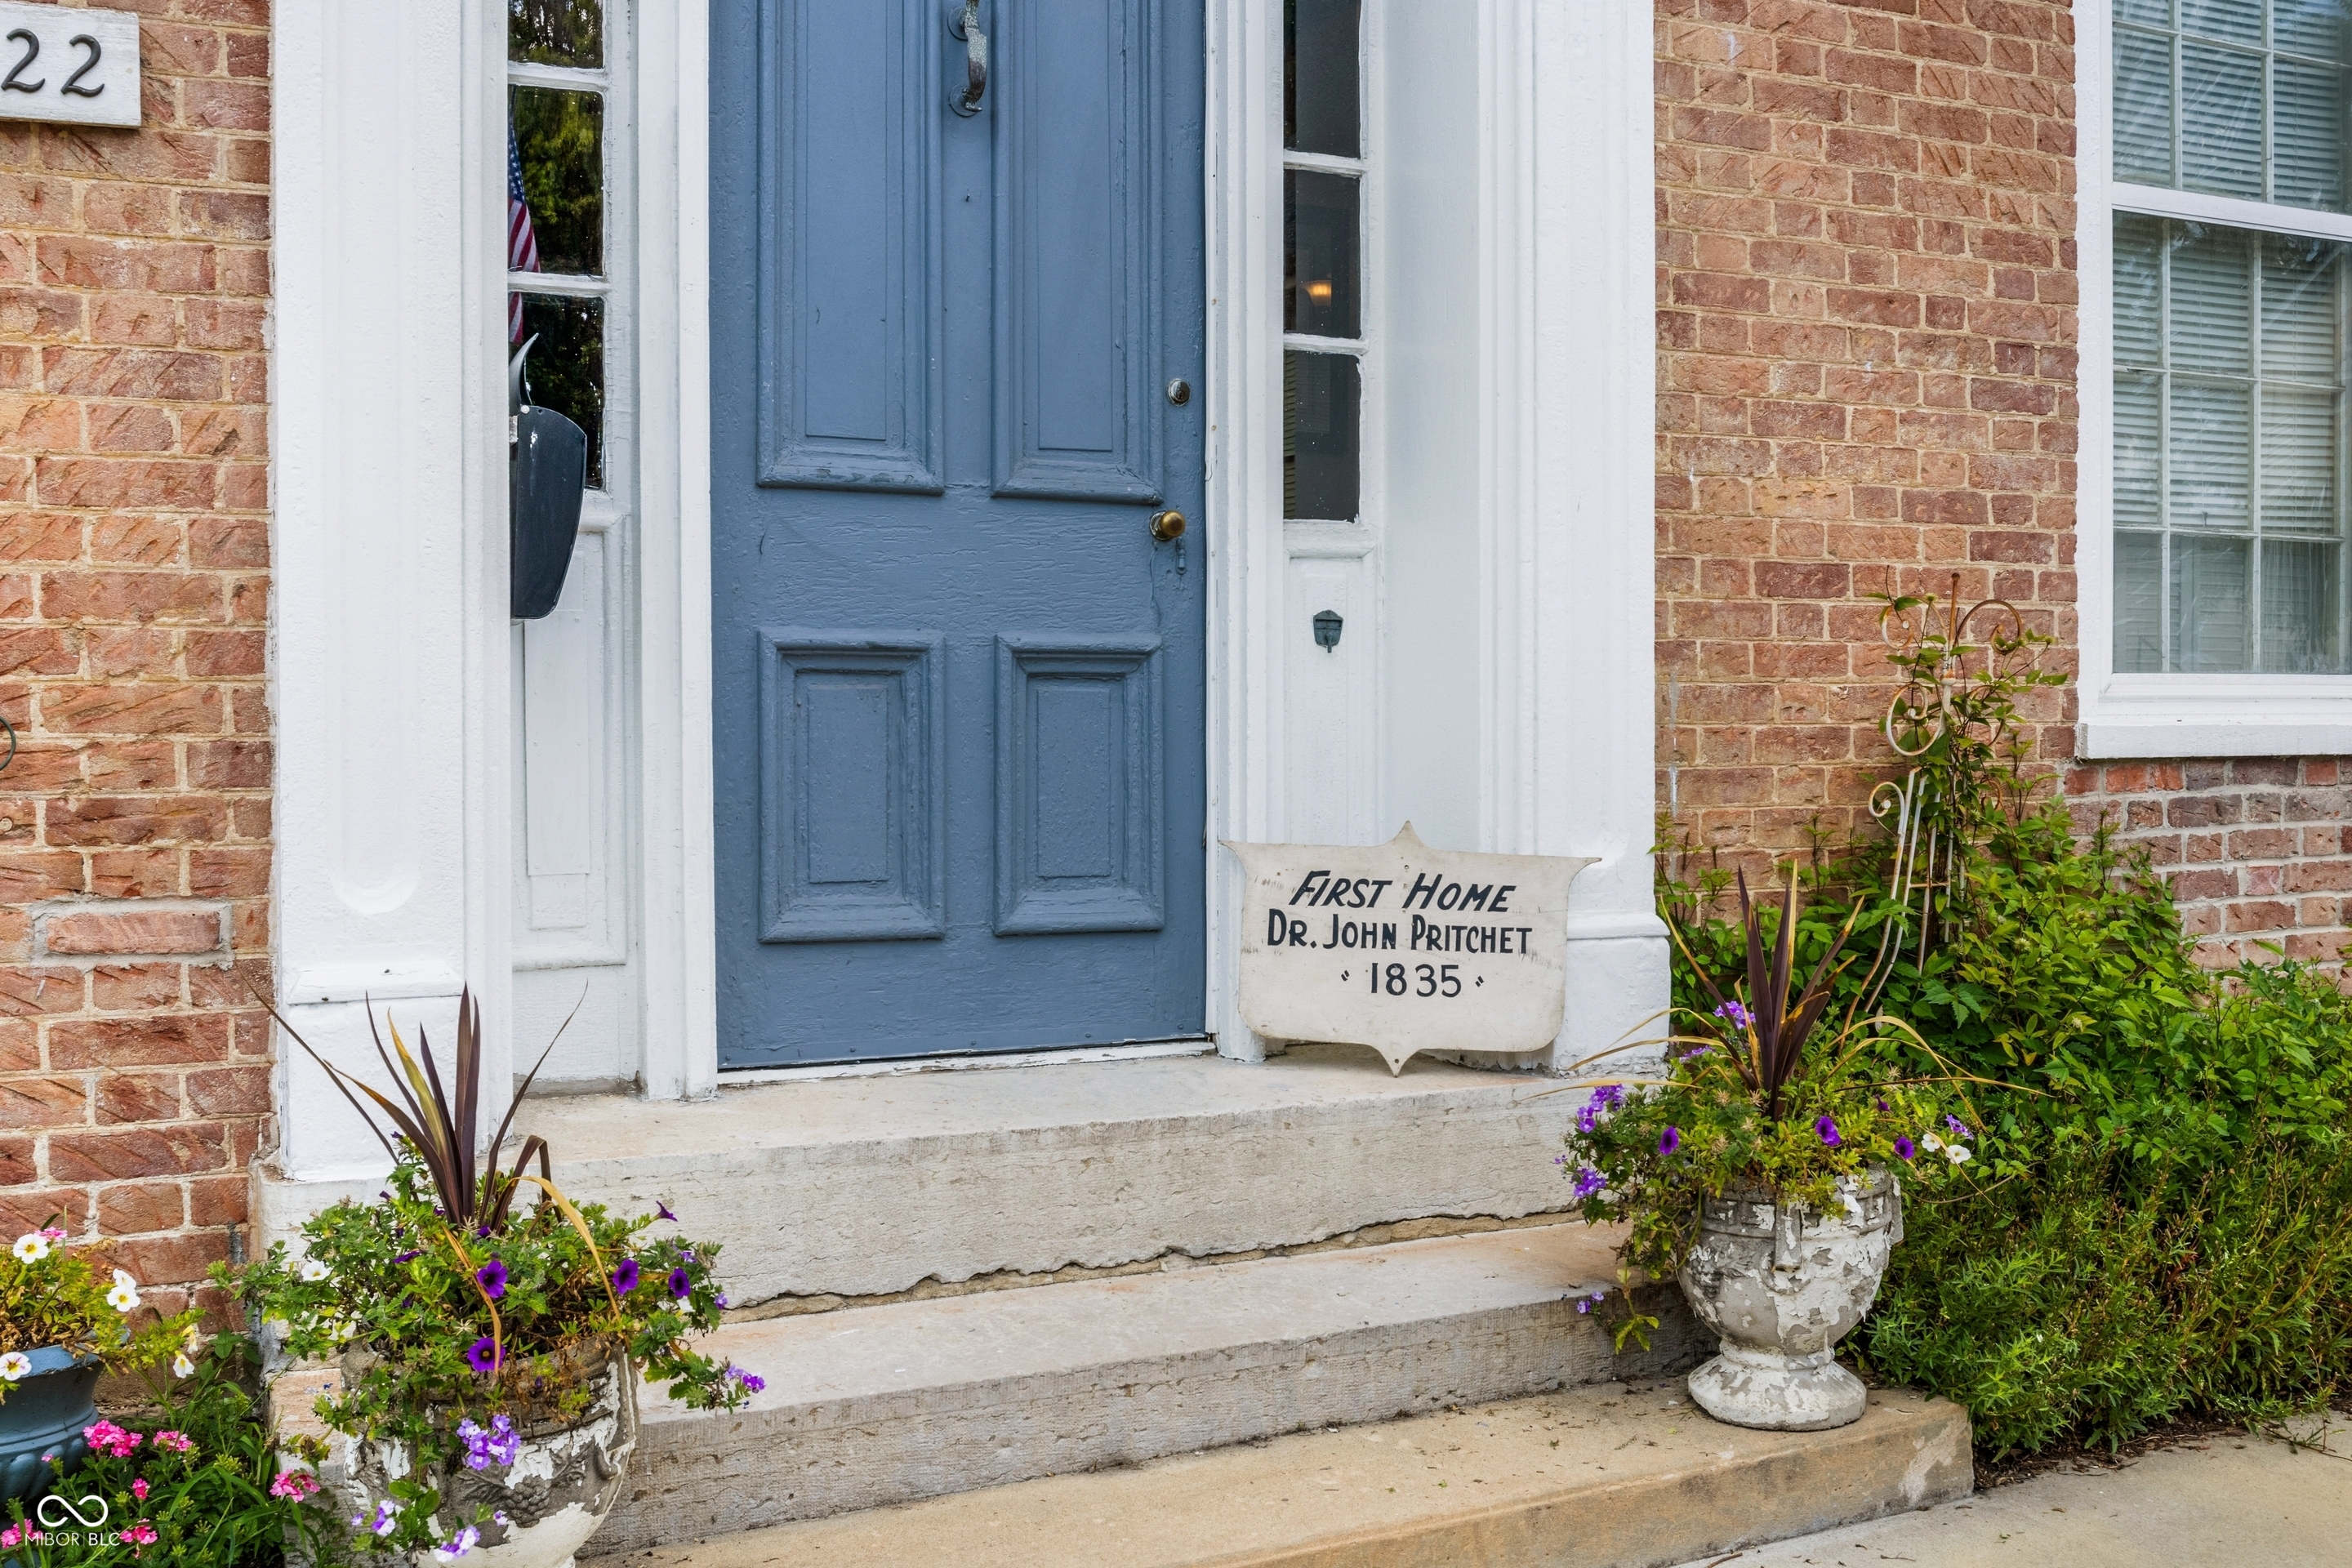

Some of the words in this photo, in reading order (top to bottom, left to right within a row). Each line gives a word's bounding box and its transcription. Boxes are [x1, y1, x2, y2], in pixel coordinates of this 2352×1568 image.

[1, 28, 105, 97] 22
[1289, 870, 1393, 909] FIRST
[1402, 872, 1517, 913] HOME
[1267, 908, 1318, 949] DR.
[1322, 913, 1397, 950] JOHN
[1410, 914, 1533, 955] PRITCHET
[1370, 962, 1463, 998] 1835
